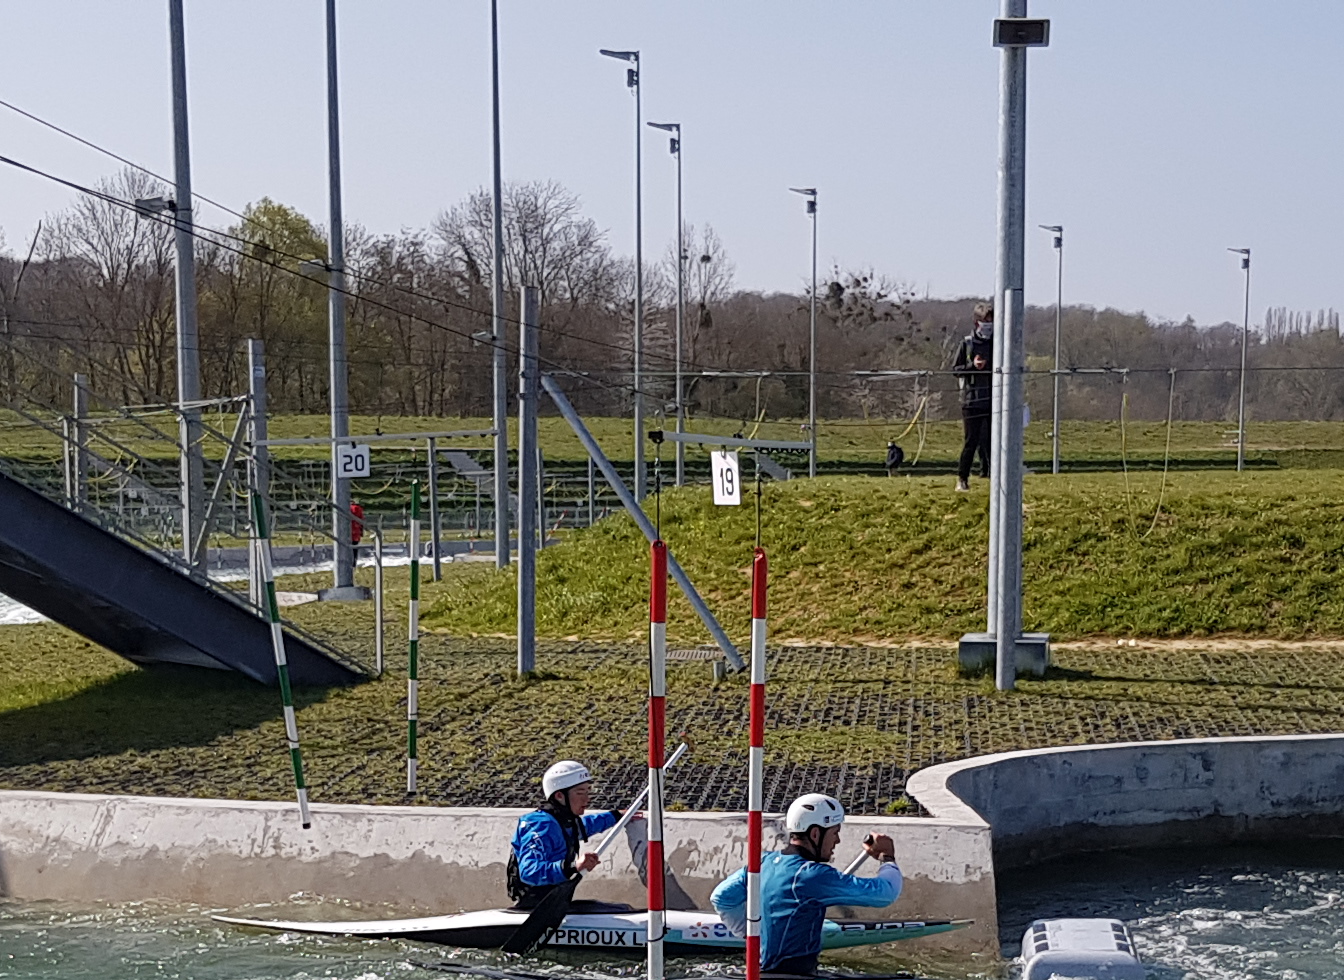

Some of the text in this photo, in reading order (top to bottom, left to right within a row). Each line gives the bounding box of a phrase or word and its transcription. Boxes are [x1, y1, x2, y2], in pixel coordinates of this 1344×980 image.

[342, 453, 365, 473] 20
[720, 467, 735, 497] 19
[555, 929, 627, 946] PRIOUX
